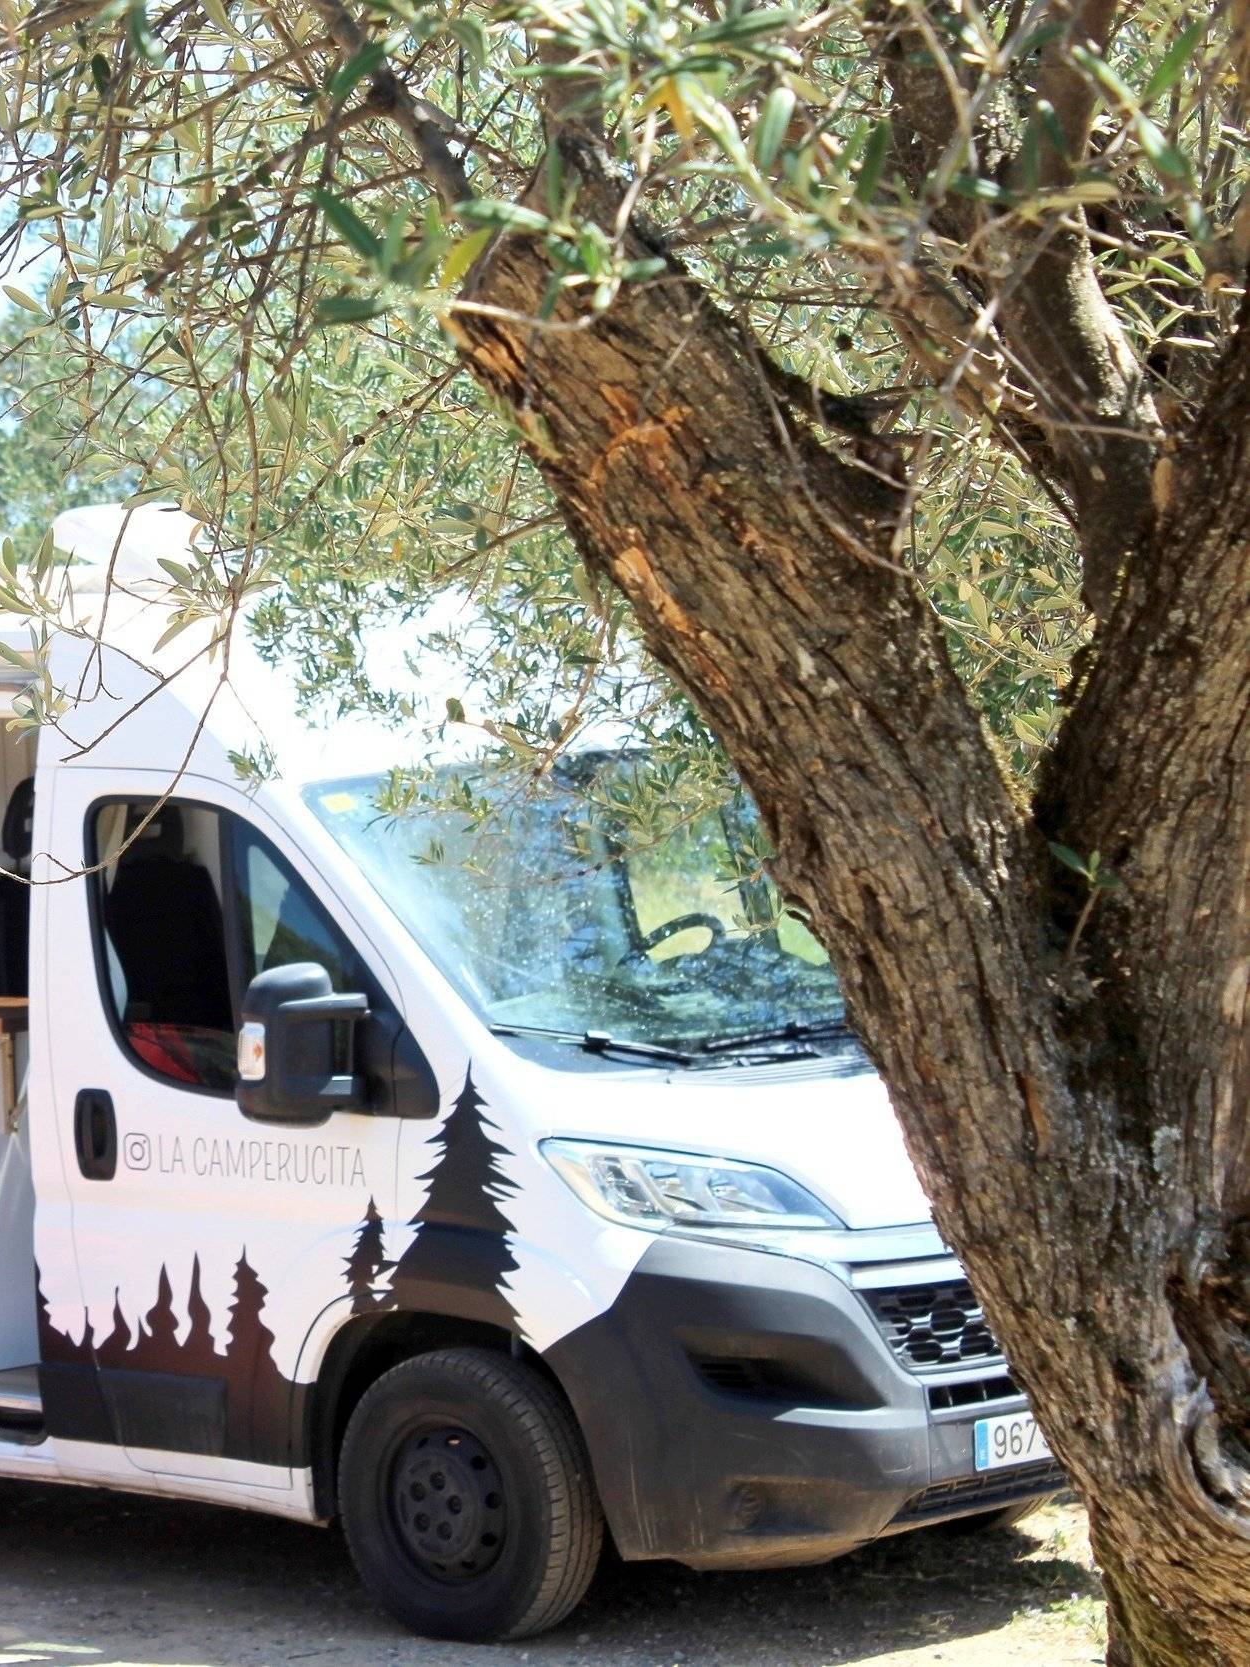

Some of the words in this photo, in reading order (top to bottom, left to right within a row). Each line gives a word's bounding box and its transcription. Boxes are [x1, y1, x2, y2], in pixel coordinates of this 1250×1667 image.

[158, 1135, 187, 1174] LA
[193, 1137, 367, 1187] CAMPERUCITA
[994, 1418, 1049, 1459] 967
